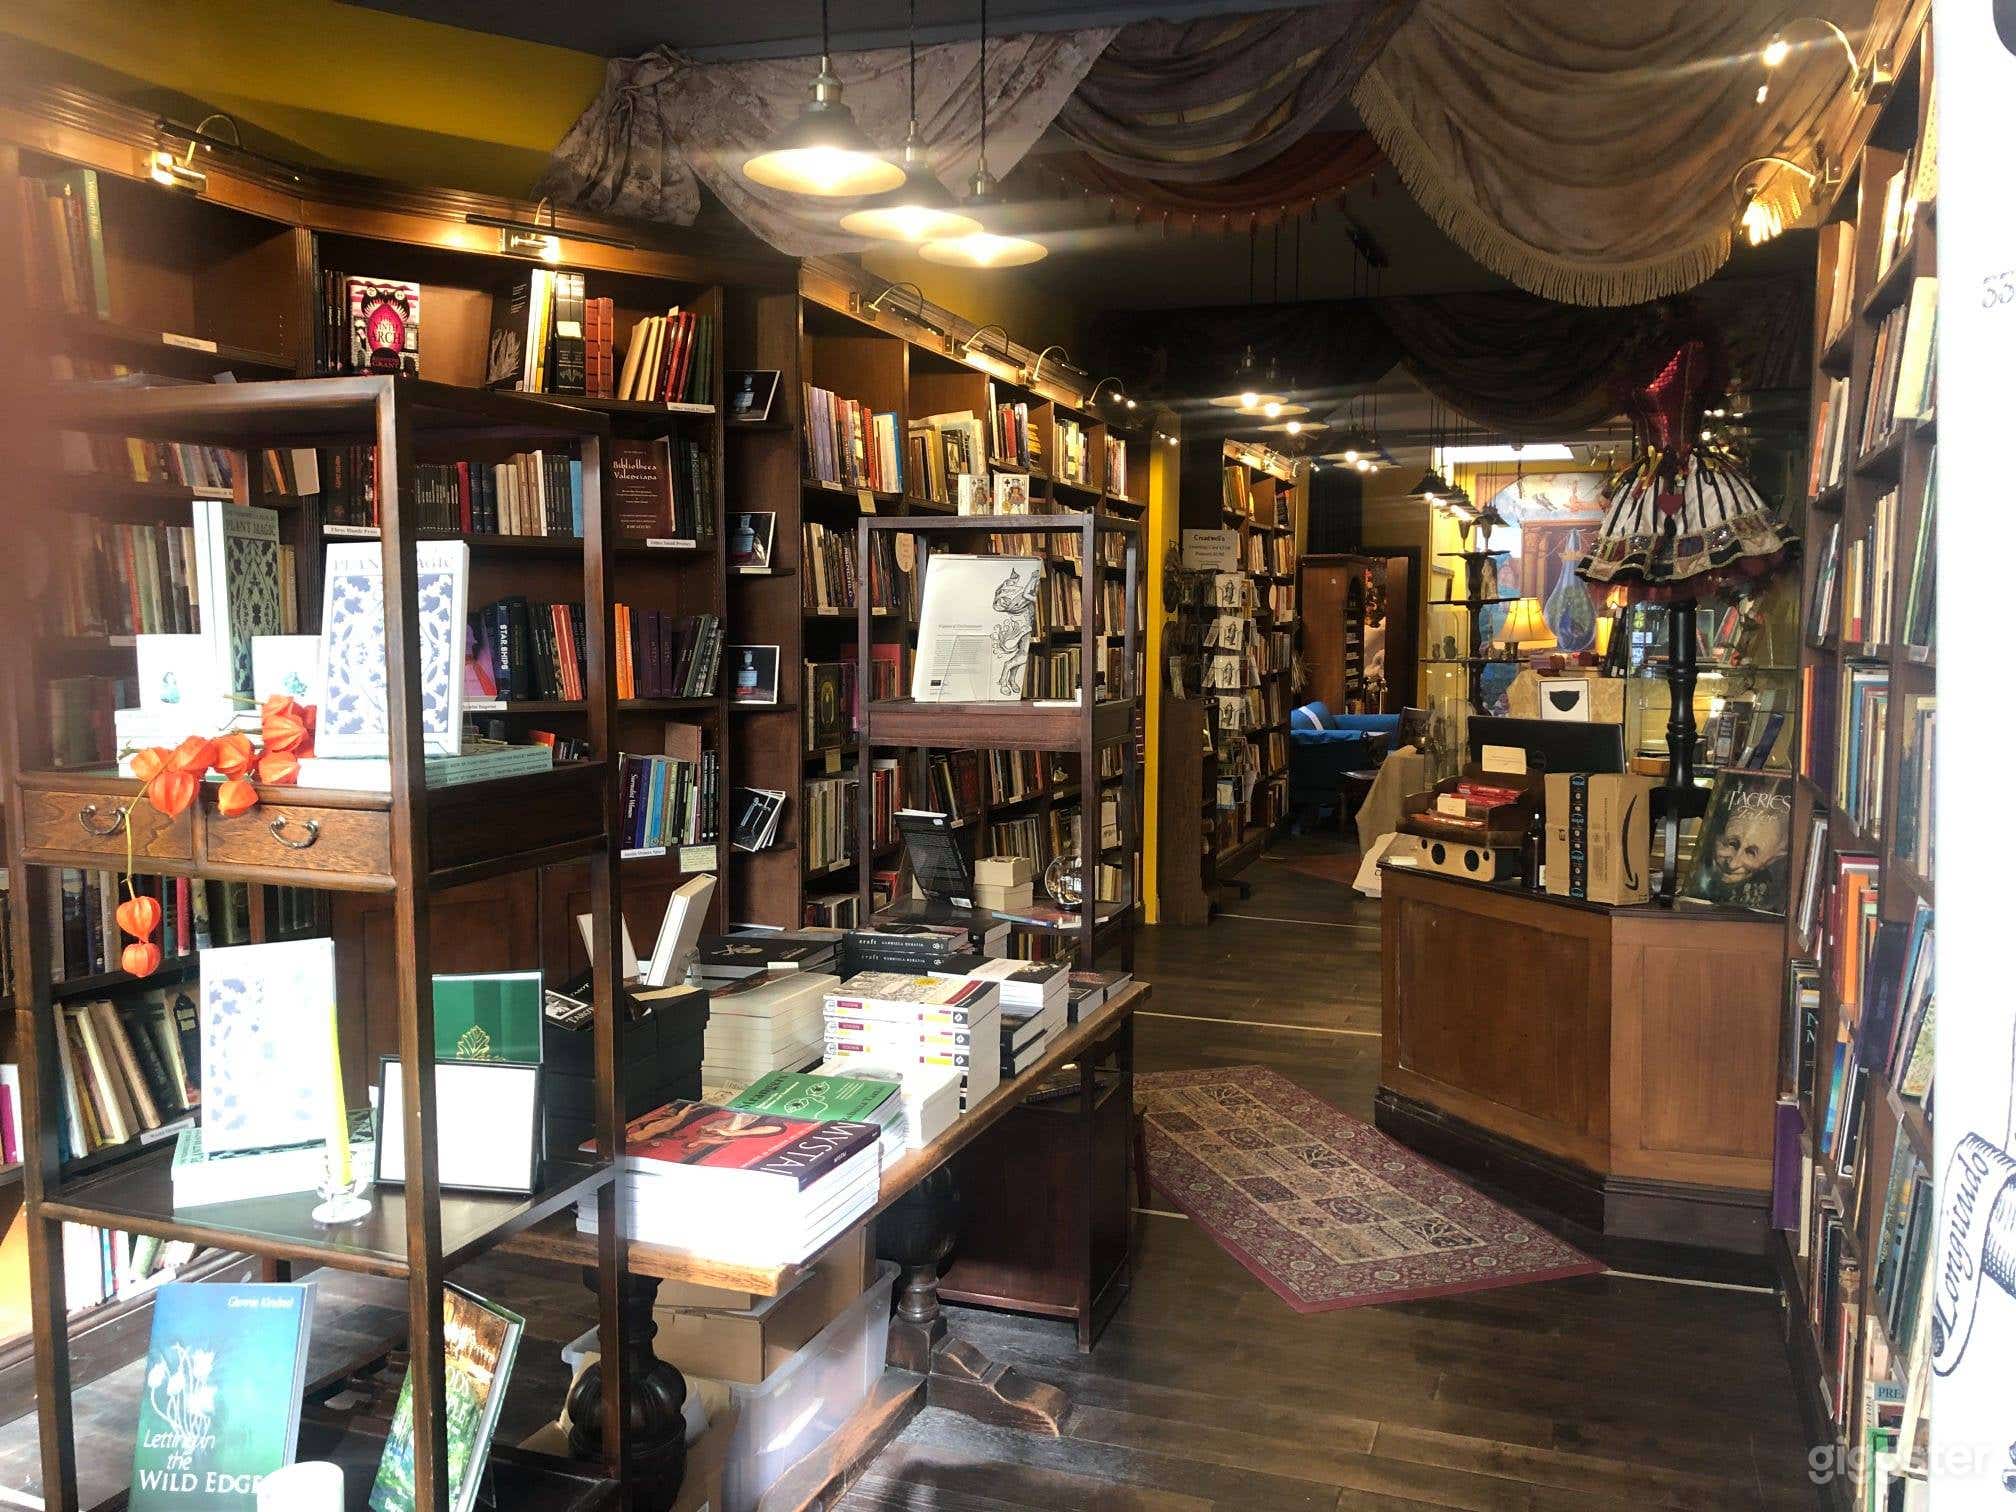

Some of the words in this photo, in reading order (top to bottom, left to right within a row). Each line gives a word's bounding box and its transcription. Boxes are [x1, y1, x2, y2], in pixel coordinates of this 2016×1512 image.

[760, 1122, 867, 1175] MYSTAI
[1878, 1382, 1904, 1400] PRE
[167, 1450, 193, 1471] the
[139, 1469, 198, 1493] WILD
